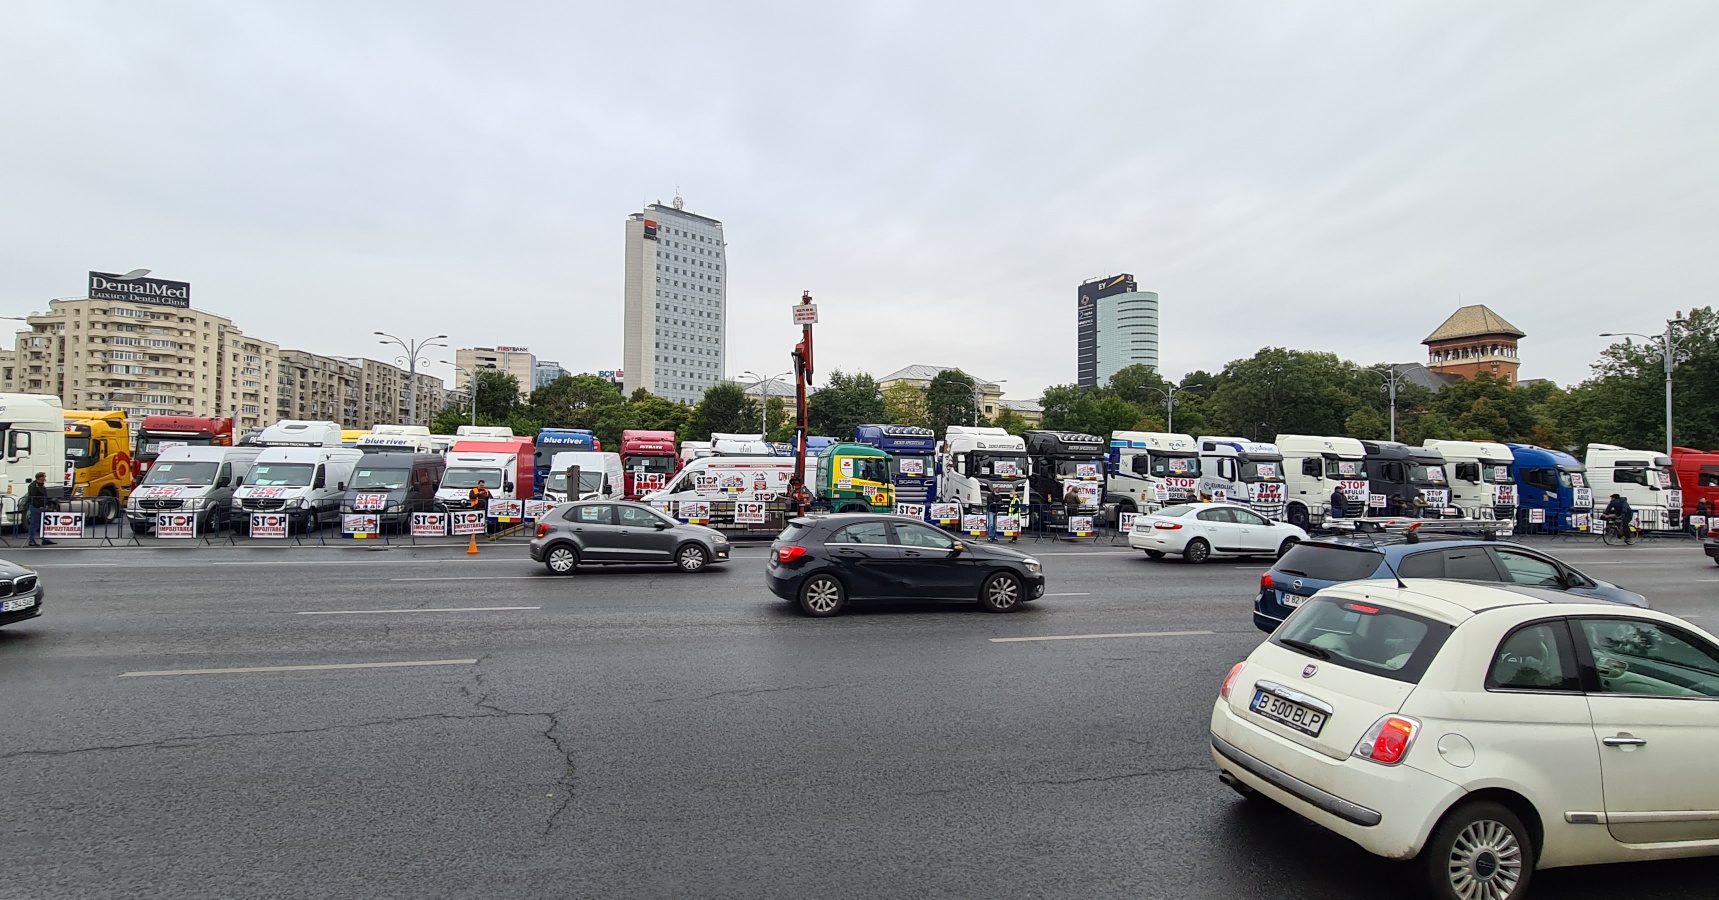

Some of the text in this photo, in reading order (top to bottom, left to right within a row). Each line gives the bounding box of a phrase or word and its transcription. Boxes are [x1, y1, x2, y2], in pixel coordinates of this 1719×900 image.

[92, 276, 187, 298] DentalMed
[1098, 282, 1106, 290] EY
[92, 290, 187, 306] Luxury Dental Clinic
[636, 474, 664, 482] STOP
[1166, 477, 1195, 487] STOP
[1260, 483, 1280, 493] STOP
[1340, 481, 1365, 489] STOP
[738, 504, 763, 513] STOP
[899, 505, 923, 515] STOP
[44, 515, 82, 526] STOP
[160, 516, 194, 526] STOP
[253, 516, 286, 526] STOP
[414, 515, 444, 525] STOP
[454, 513, 483, 524] STOP
[1258, 694, 1270, 708] B
[1270, 699, 1293, 718] 500
[1292, 708, 1320, 727] BLP
